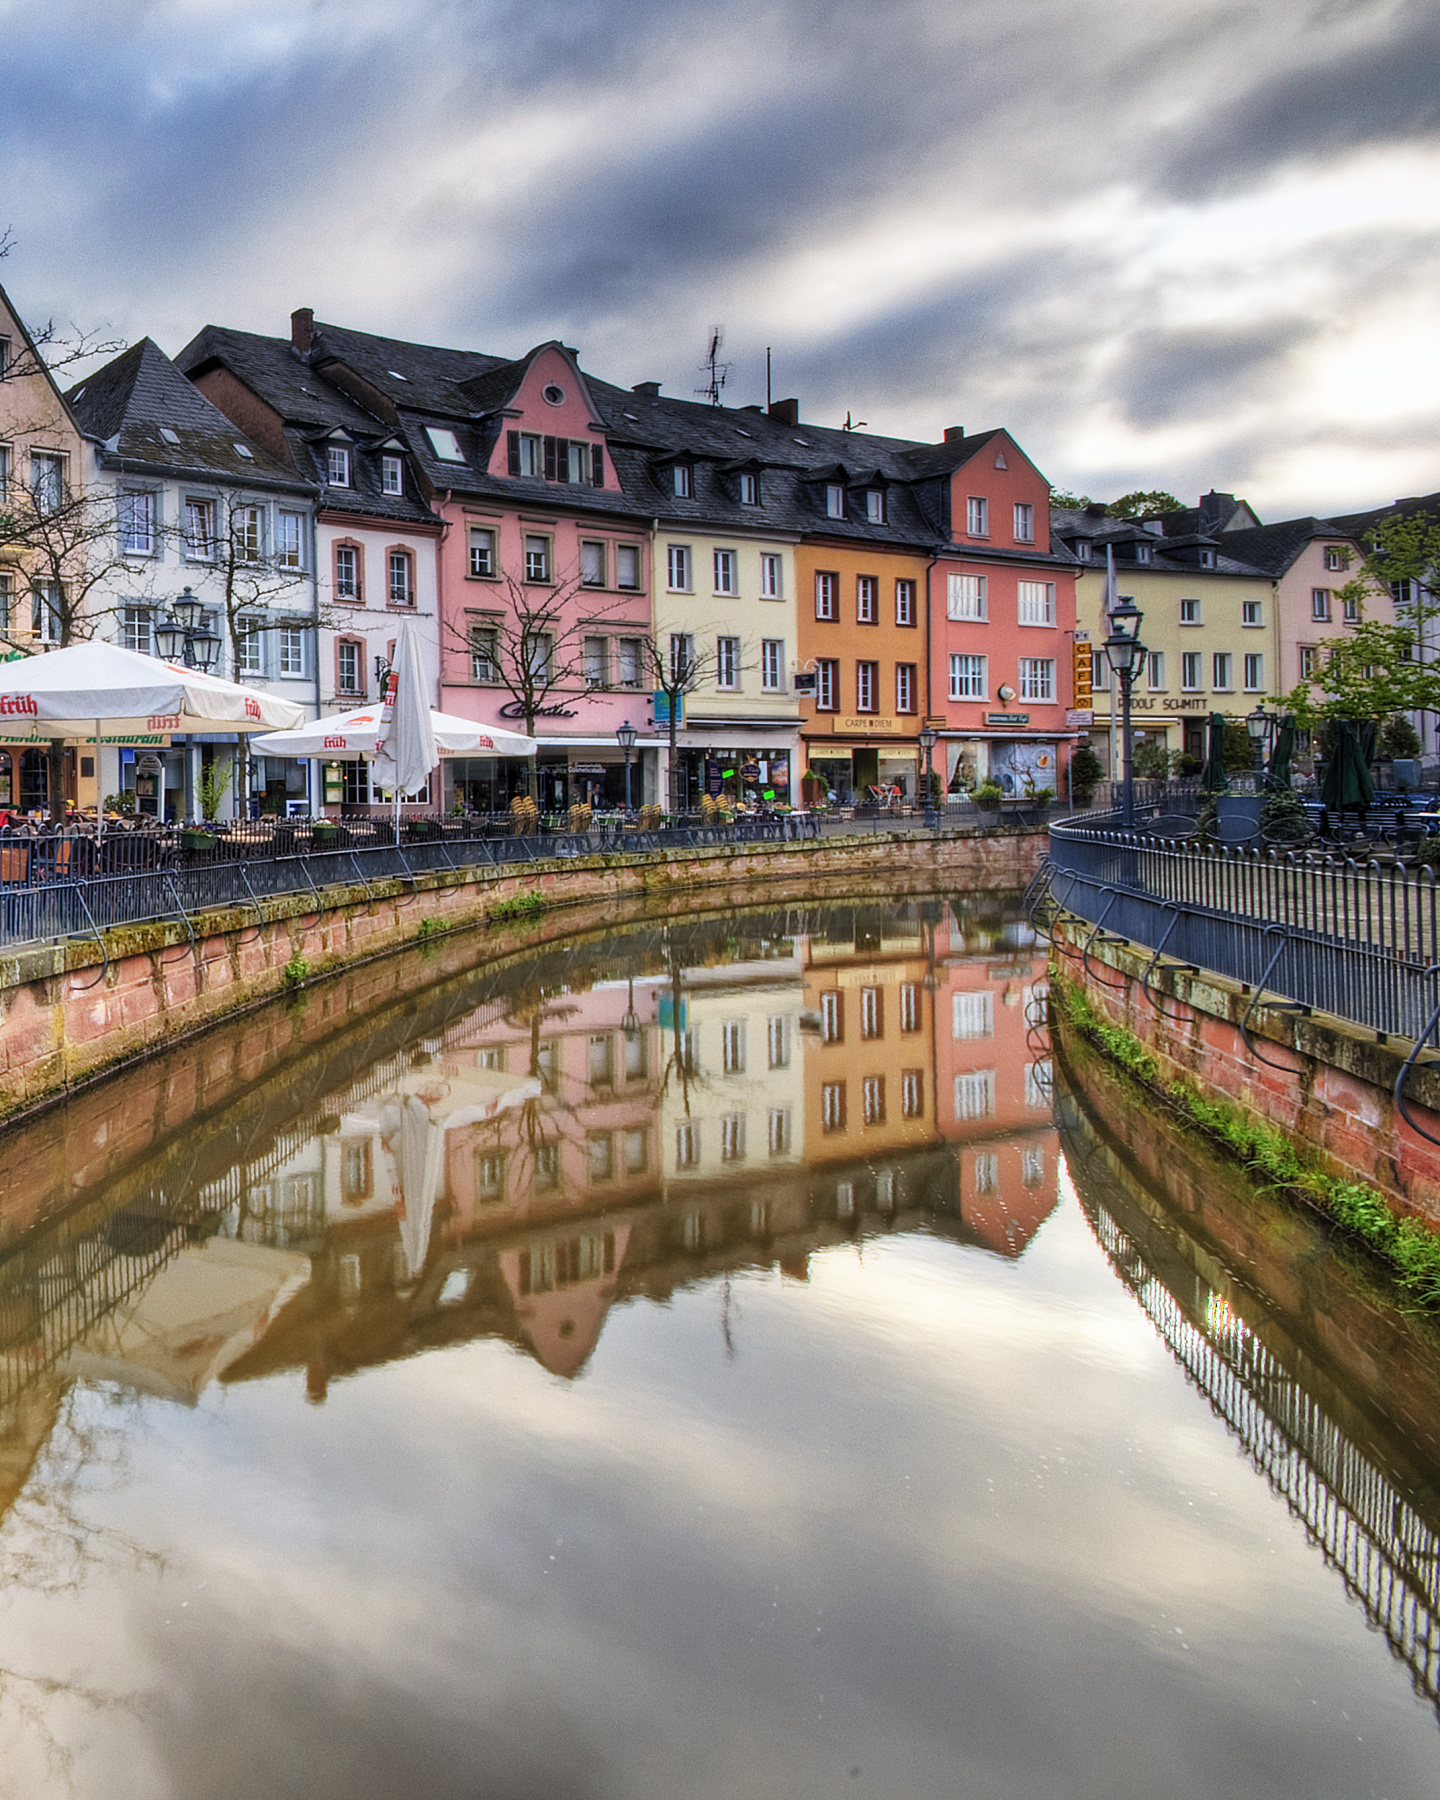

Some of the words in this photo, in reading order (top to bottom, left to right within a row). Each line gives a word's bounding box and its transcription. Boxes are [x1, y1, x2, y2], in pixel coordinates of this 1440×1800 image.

[1075, 644, 1087, 694] CAFE
[0, 694, 38, 717] früh
[244, 697, 261, 721] früh
[1117, 697, 1157, 709] RDOLF
[1163, 698, 1208, 710] SCHMITT
[845, 718, 868, 728] CARPE
[875, 719, 892, 728] DIEM
[324, 736, 347, 749] früh
[479, 735, 494, 749] früh
